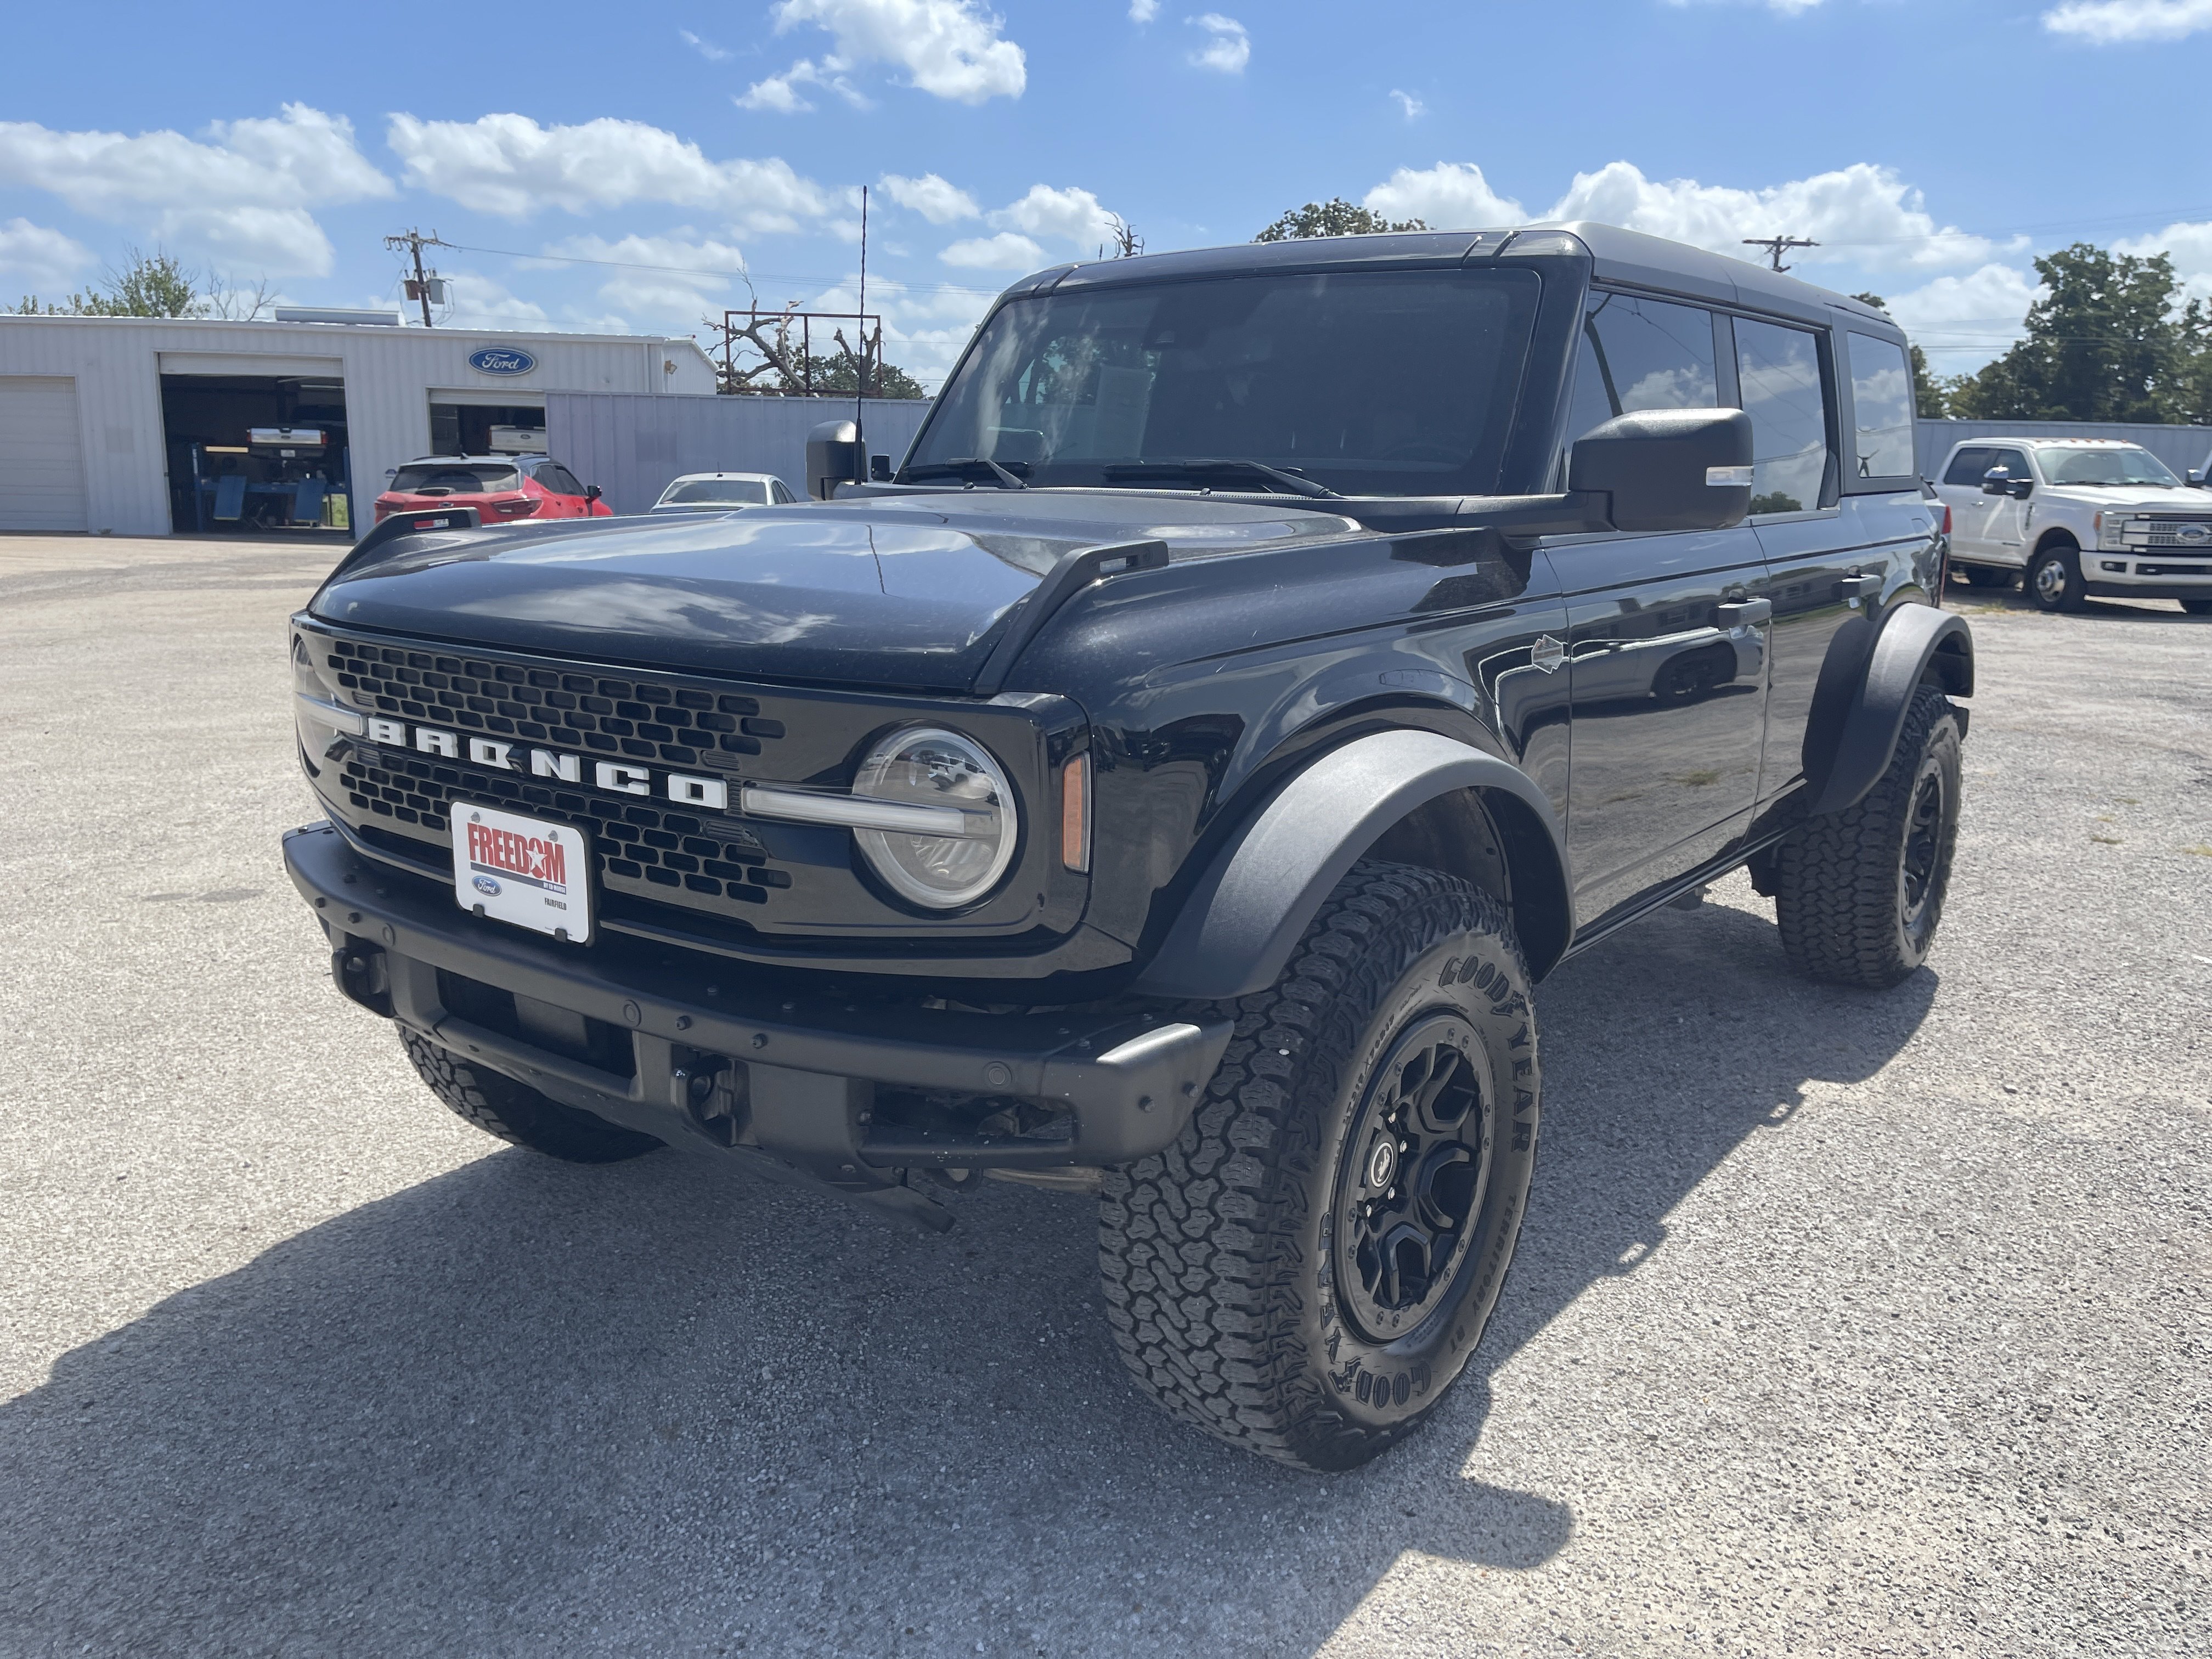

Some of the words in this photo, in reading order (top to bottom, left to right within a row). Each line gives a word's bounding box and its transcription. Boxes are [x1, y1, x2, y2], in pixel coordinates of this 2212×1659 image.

[482, 353, 520, 369] Ford
[368, 716, 727, 810] BRONCO
[467, 822, 566, 885] FREEDOM
[478, 878, 496, 894] Ford
[544, 897, 567, 911] FAIRFIELD
[1472, 1194, 1517, 1317] TERRITORY
